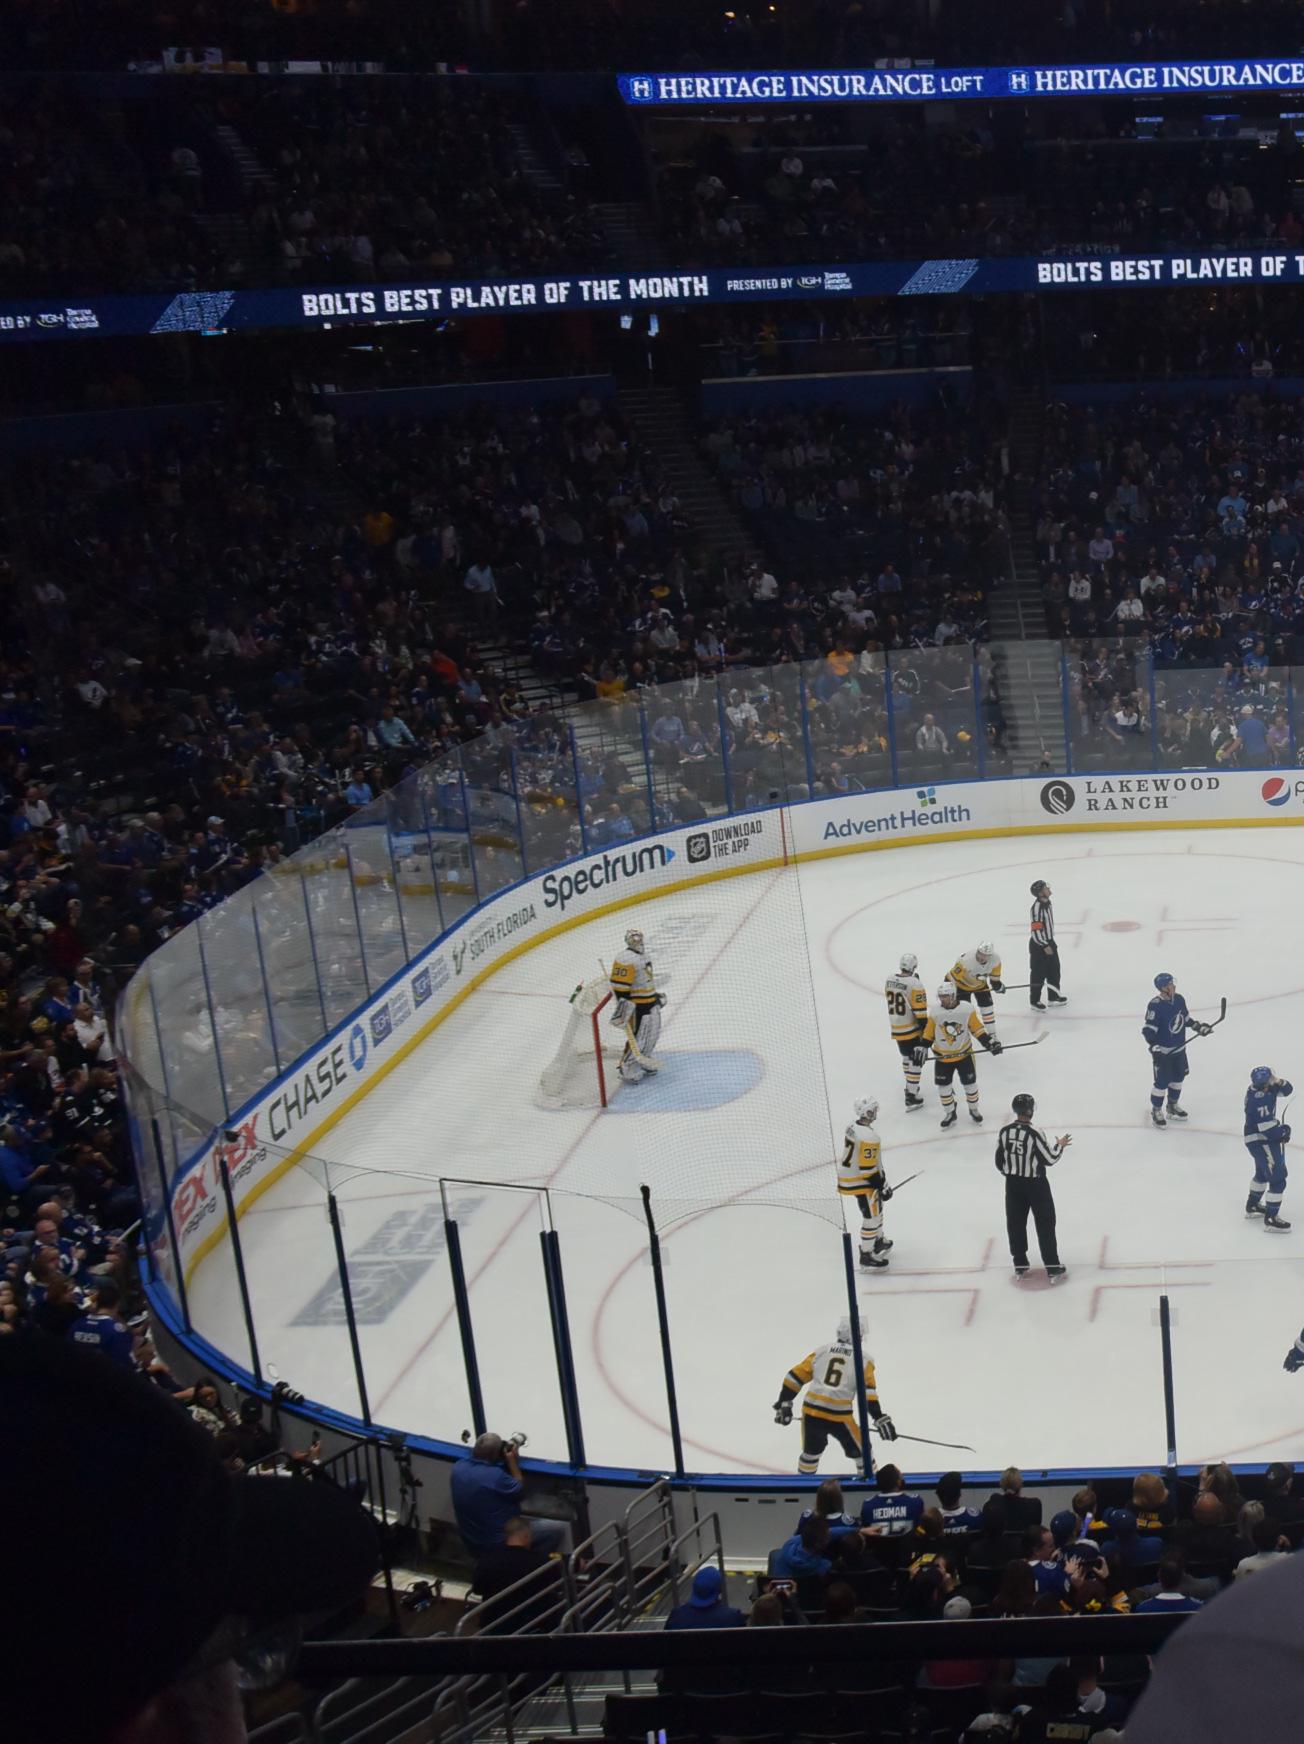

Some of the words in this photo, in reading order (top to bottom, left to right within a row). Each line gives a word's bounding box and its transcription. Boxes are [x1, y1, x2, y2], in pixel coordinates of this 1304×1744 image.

[658, 76, 787, 99] HERITAGE
[790, 73, 936, 97] INSURANCE
[941, 76, 984, 92] LOFT
[1034, 68, 1157, 91] HERITAGE
[1037, 261, 1103, 284] BOLTS
[1110, 259, 1163, 281] BEST
[1171, 256, 1253, 279] PLAYER
[1260, 256, 1287, 277] OF
[302, 291, 376, 317] BOLTS
[384, 288, 442, 312] BEST
[450, 283, 536, 309] PLAYER
[543, 282, 571, 303] OF
[578, 279, 622, 301] THE
[628, 276, 709, 299] MONTH
[727, 279, 778, 291] PRESENTED
[780, 278, 793, 289] BY
[1086, 776, 1220, 794] LAKEWOOD
[1087, 795, 1170, 811] RANCH
[712, 820, 762, 844] DOWNLOAD
[822, 805, 971, 840] AdventHealth
[712, 840, 730, 857] THE
[731, 838, 750, 854] APP
[542, 844, 667, 911] Spectrum
[470, 926, 496, 961] SOUTH
[496, 903, 537, 940] FLORIDA
[614, 967, 627, 977] 30
[887, 990, 906, 1016] 28
[268, 1043, 348, 1141] CHASE
[1258, 1106, 1270, 1117] 71
[1009, 1140, 1024, 1155] 75
[823, 1357, 846, 1387] 6
[873, 1506, 907, 1520] HEDMAN
